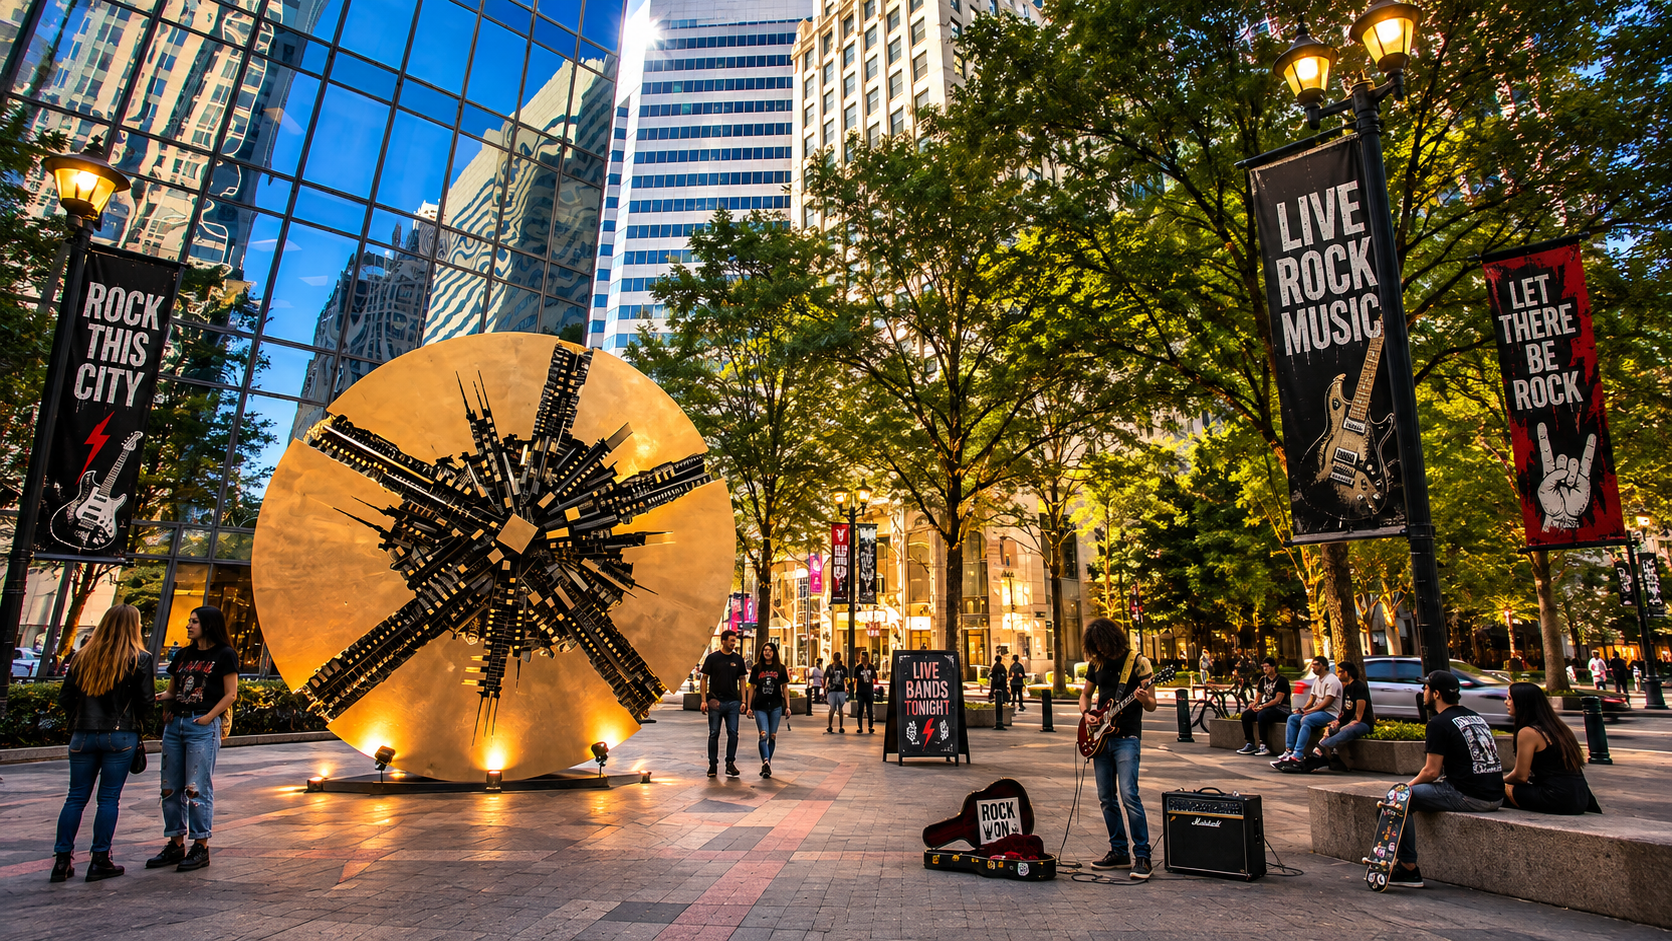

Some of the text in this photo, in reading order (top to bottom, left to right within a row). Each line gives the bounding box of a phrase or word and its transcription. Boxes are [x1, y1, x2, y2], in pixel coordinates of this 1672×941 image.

[1276, 179, 1366, 252] LIVE
[1275, 235, 1379, 307] ROCK
[1508, 273, 1550, 310] LET
[82, 281, 165, 331] ROCK
[1280, 292, 1382, 357] MUSIC
[1498, 302, 1577, 345] THERE
[86, 322, 150, 367] THIS
[1525, 339, 1560, 375] BE
[73, 362, 145, 408] CITY
[1512, 370, 1584, 411] ROCK
[905, 680, 949, 699] BANDS
[912, 661, 940, 679] LIVE
[904, 700, 950, 716] TONIGHT
[981, 801, 1016, 821] ROCK
